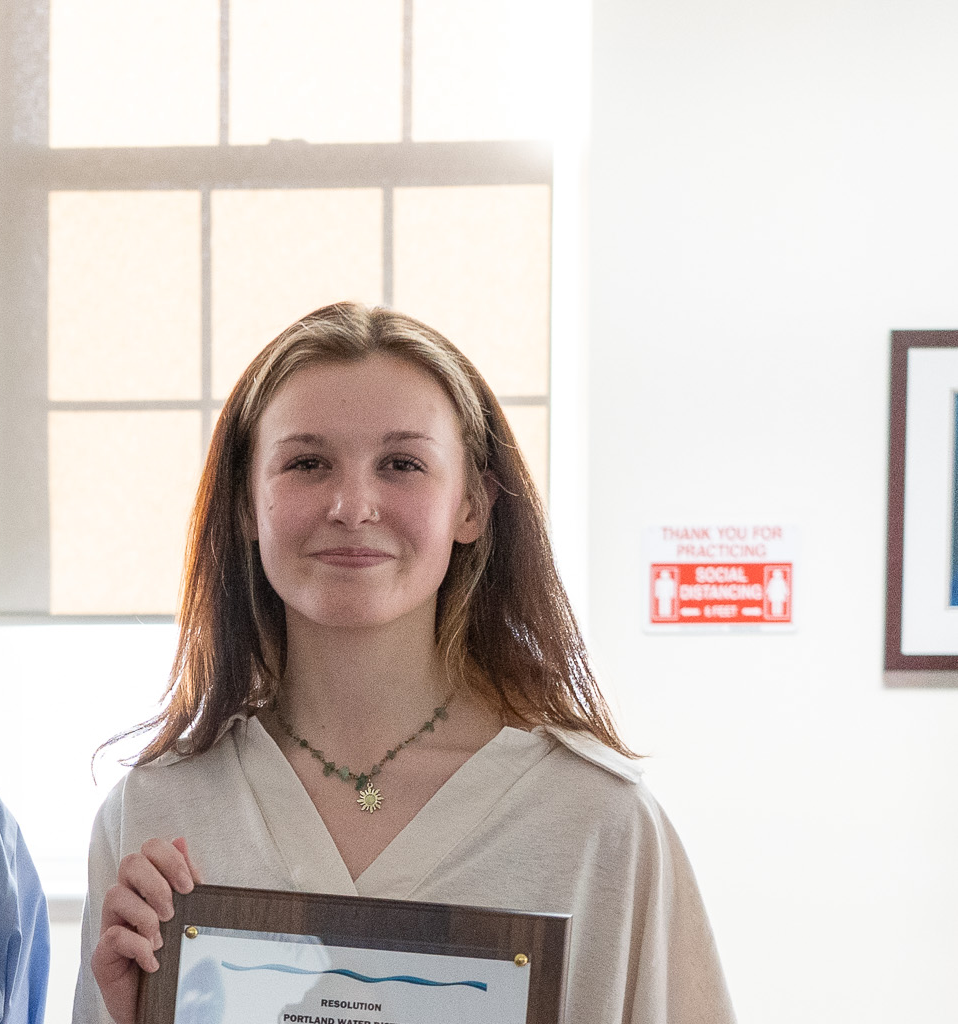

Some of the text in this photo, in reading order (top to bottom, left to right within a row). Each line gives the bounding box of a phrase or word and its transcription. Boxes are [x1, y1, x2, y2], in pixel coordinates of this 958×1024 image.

[661, 527, 782, 539] THANK YOU FOR
[677, 544, 767, 557] PRACTICING
[695, 567, 748, 583] SOCIAL
[680, 584, 762, 600] DISTANCING
[321, 999, 382, 1011] RESOLUTION
